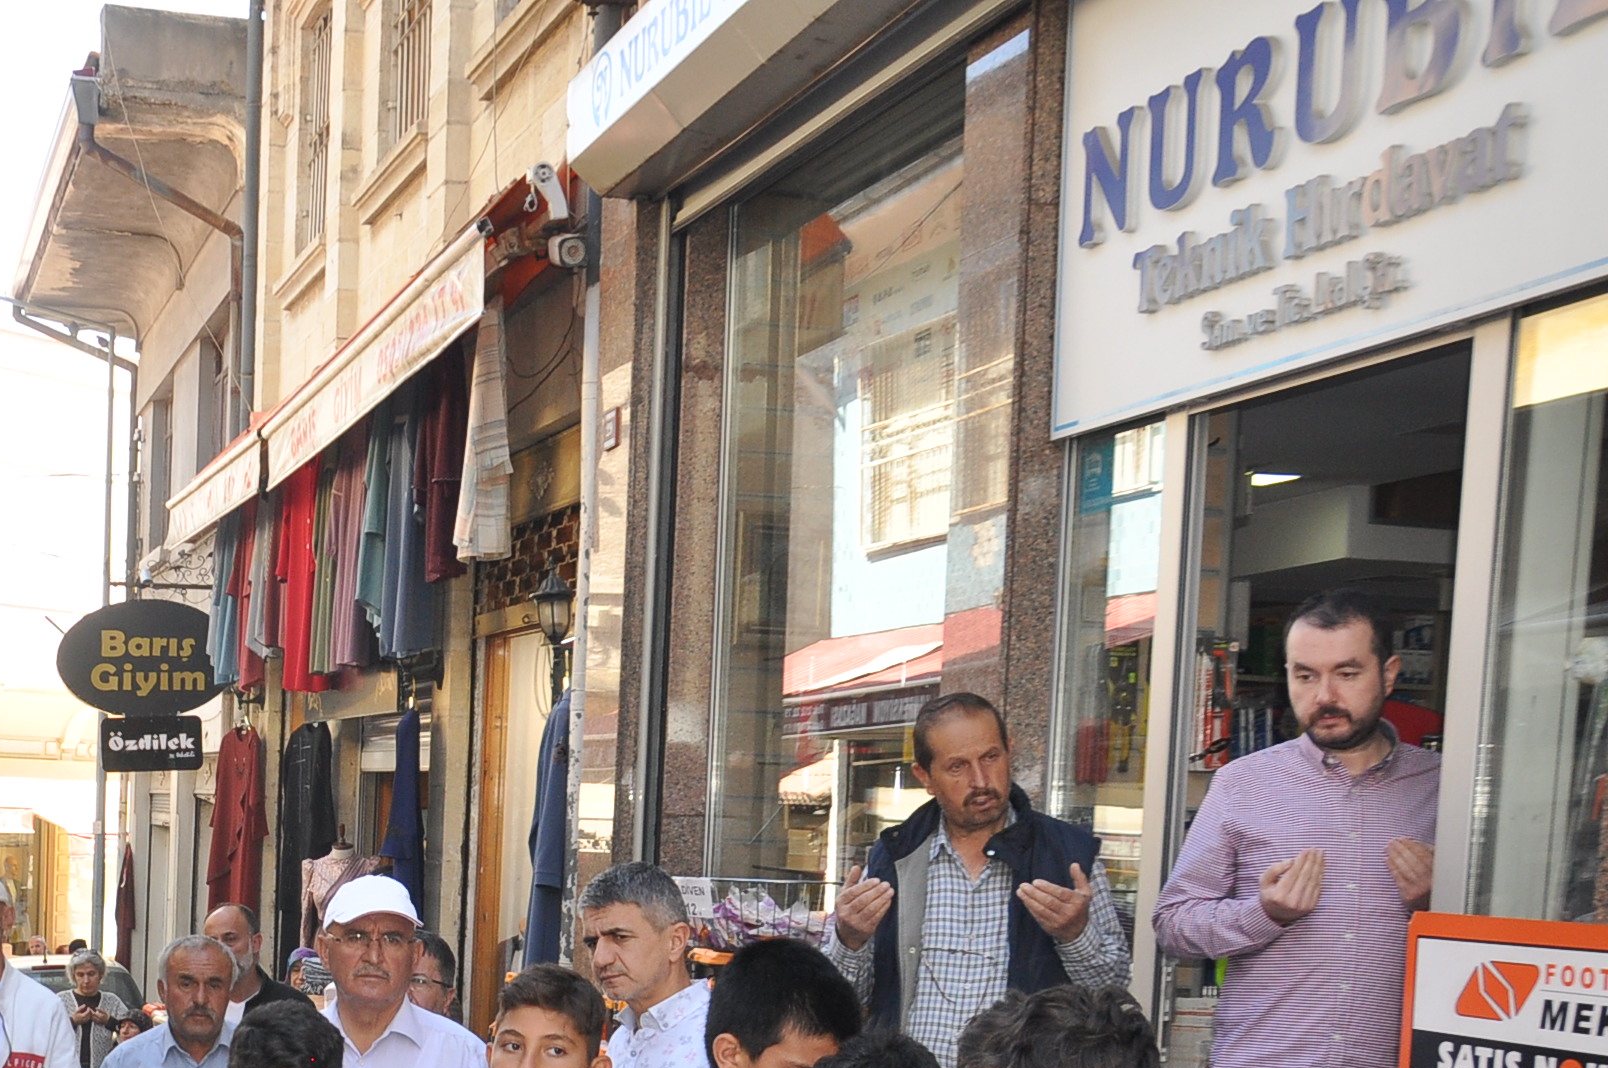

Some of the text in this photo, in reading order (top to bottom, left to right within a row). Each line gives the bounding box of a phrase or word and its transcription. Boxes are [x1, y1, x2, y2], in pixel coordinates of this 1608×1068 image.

[1132, 203, 1276, 313] Teknik
[100, 629, 196, 662] Barış
[90, 662, 206, 697] Giyim
[107, 730, 196, 752] Özdilek
